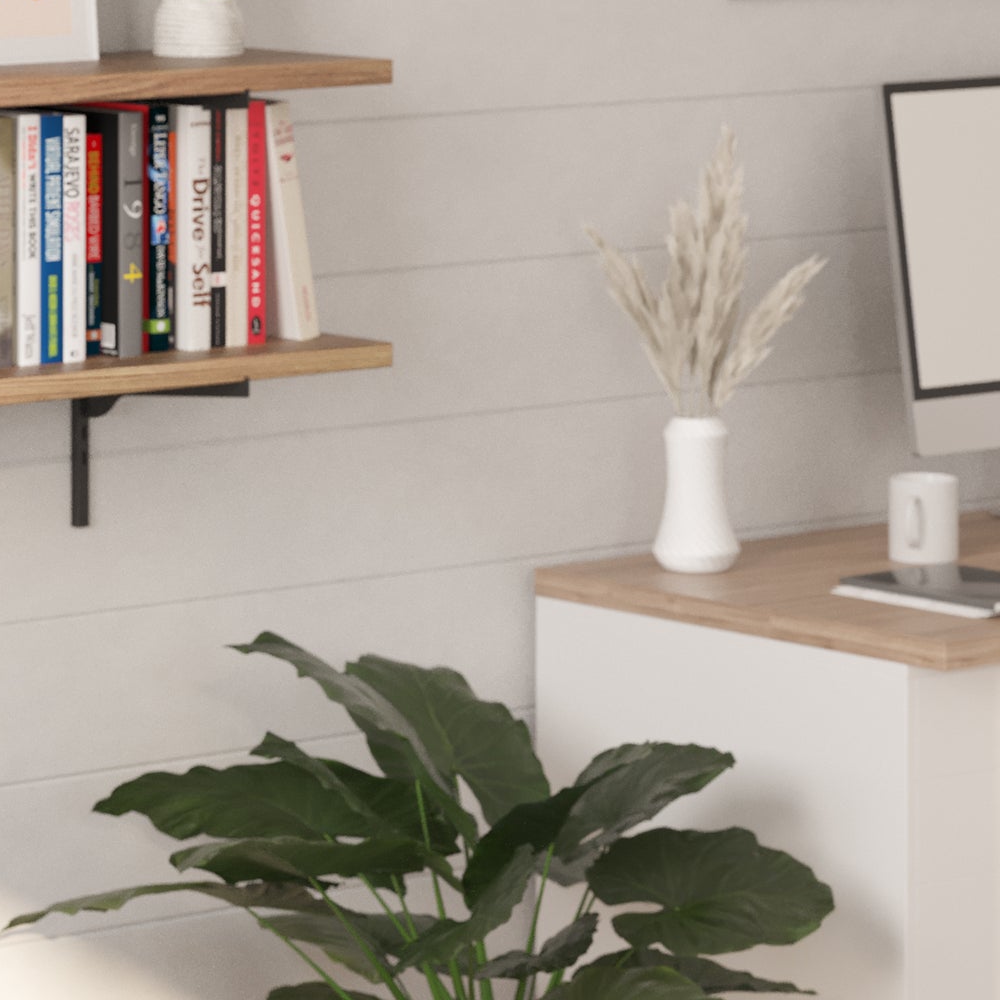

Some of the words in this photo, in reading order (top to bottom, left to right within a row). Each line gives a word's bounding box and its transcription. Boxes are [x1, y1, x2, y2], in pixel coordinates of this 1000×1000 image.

[63, 127, 81, 199] SARAJEVO
[193, 178, 209, 241] Drive
[28, 230, 38, 260] BOOK
[192, 263, 212, 308] Self
